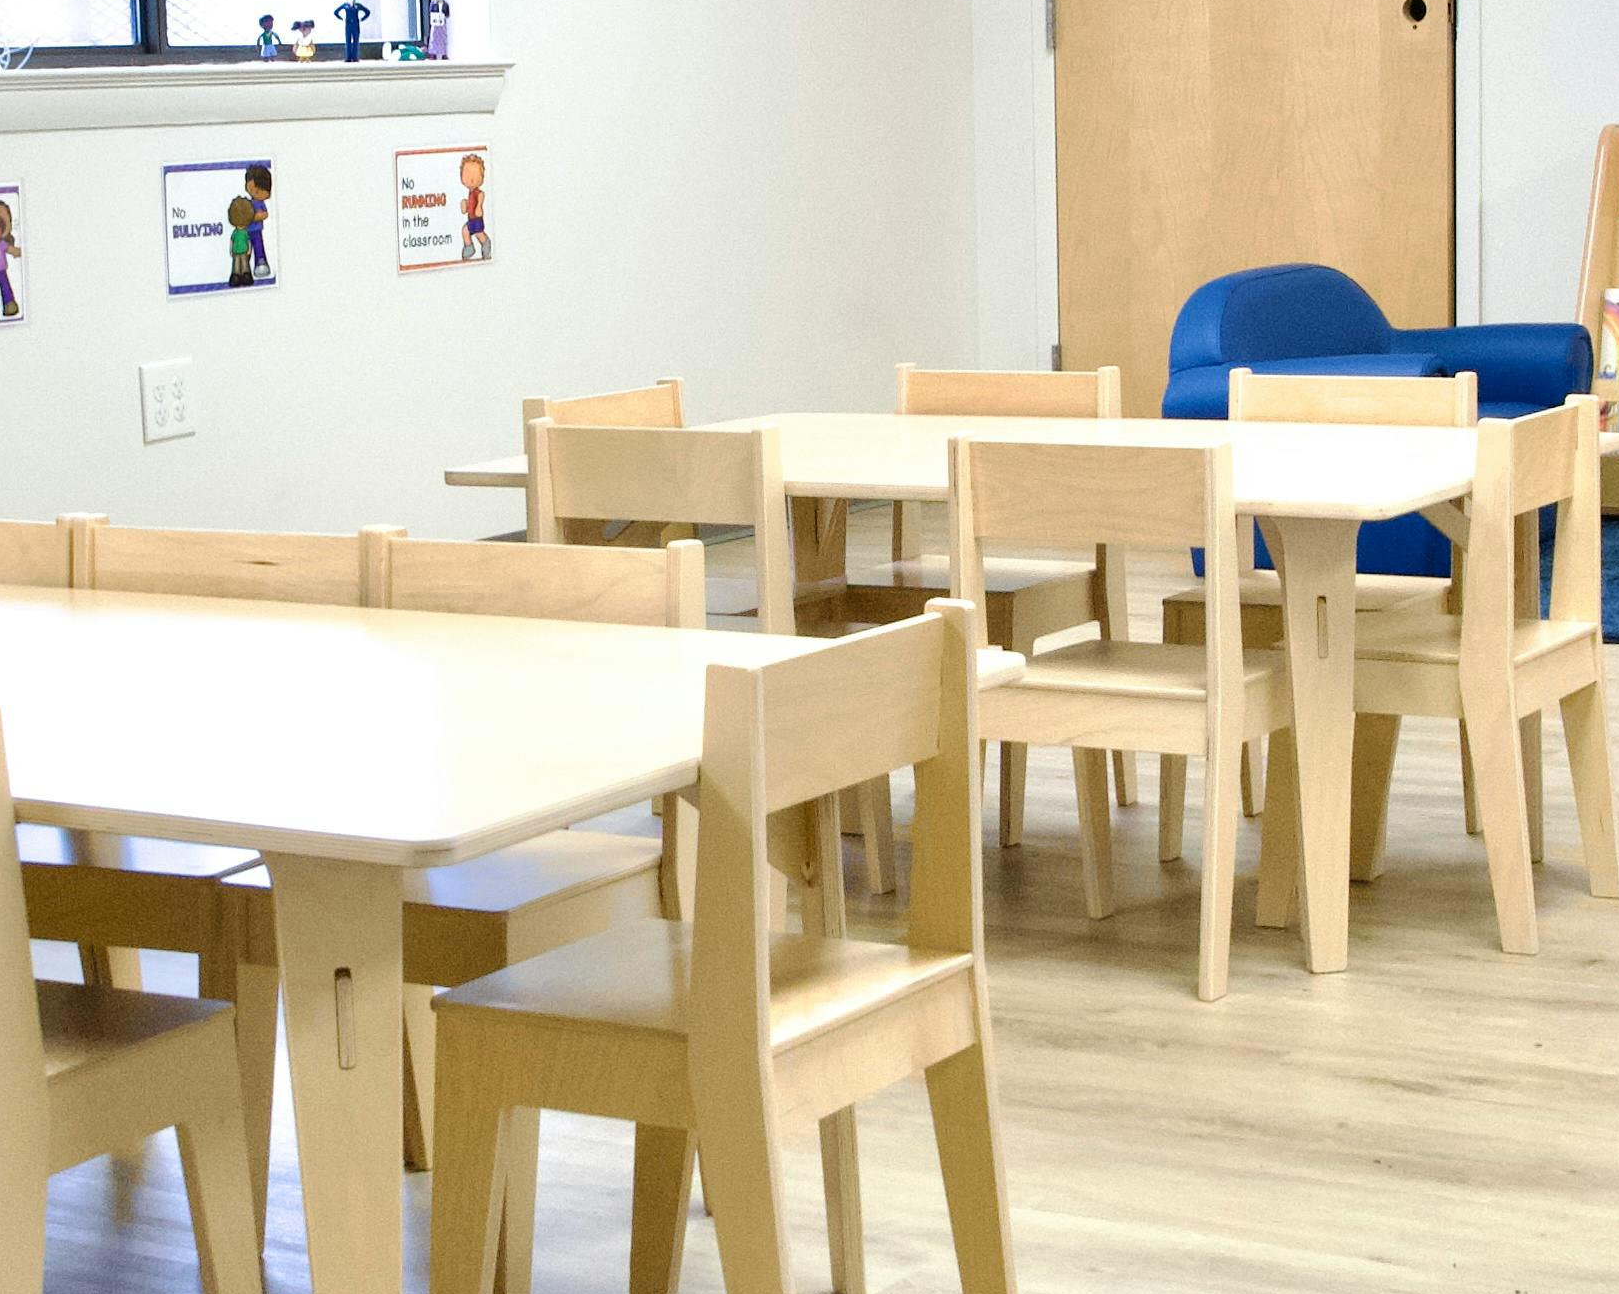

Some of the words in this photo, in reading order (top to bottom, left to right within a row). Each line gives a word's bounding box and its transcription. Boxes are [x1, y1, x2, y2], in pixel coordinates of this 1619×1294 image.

[402, 177, 414, 190] No
[402, 193, 446, 209] RUNNING
[172, 207, 186, 219] No
[413, 214, 429, 227] the
[173, 222, 223, 238] BULLYING
[403, 234, 452, 248] classroom
